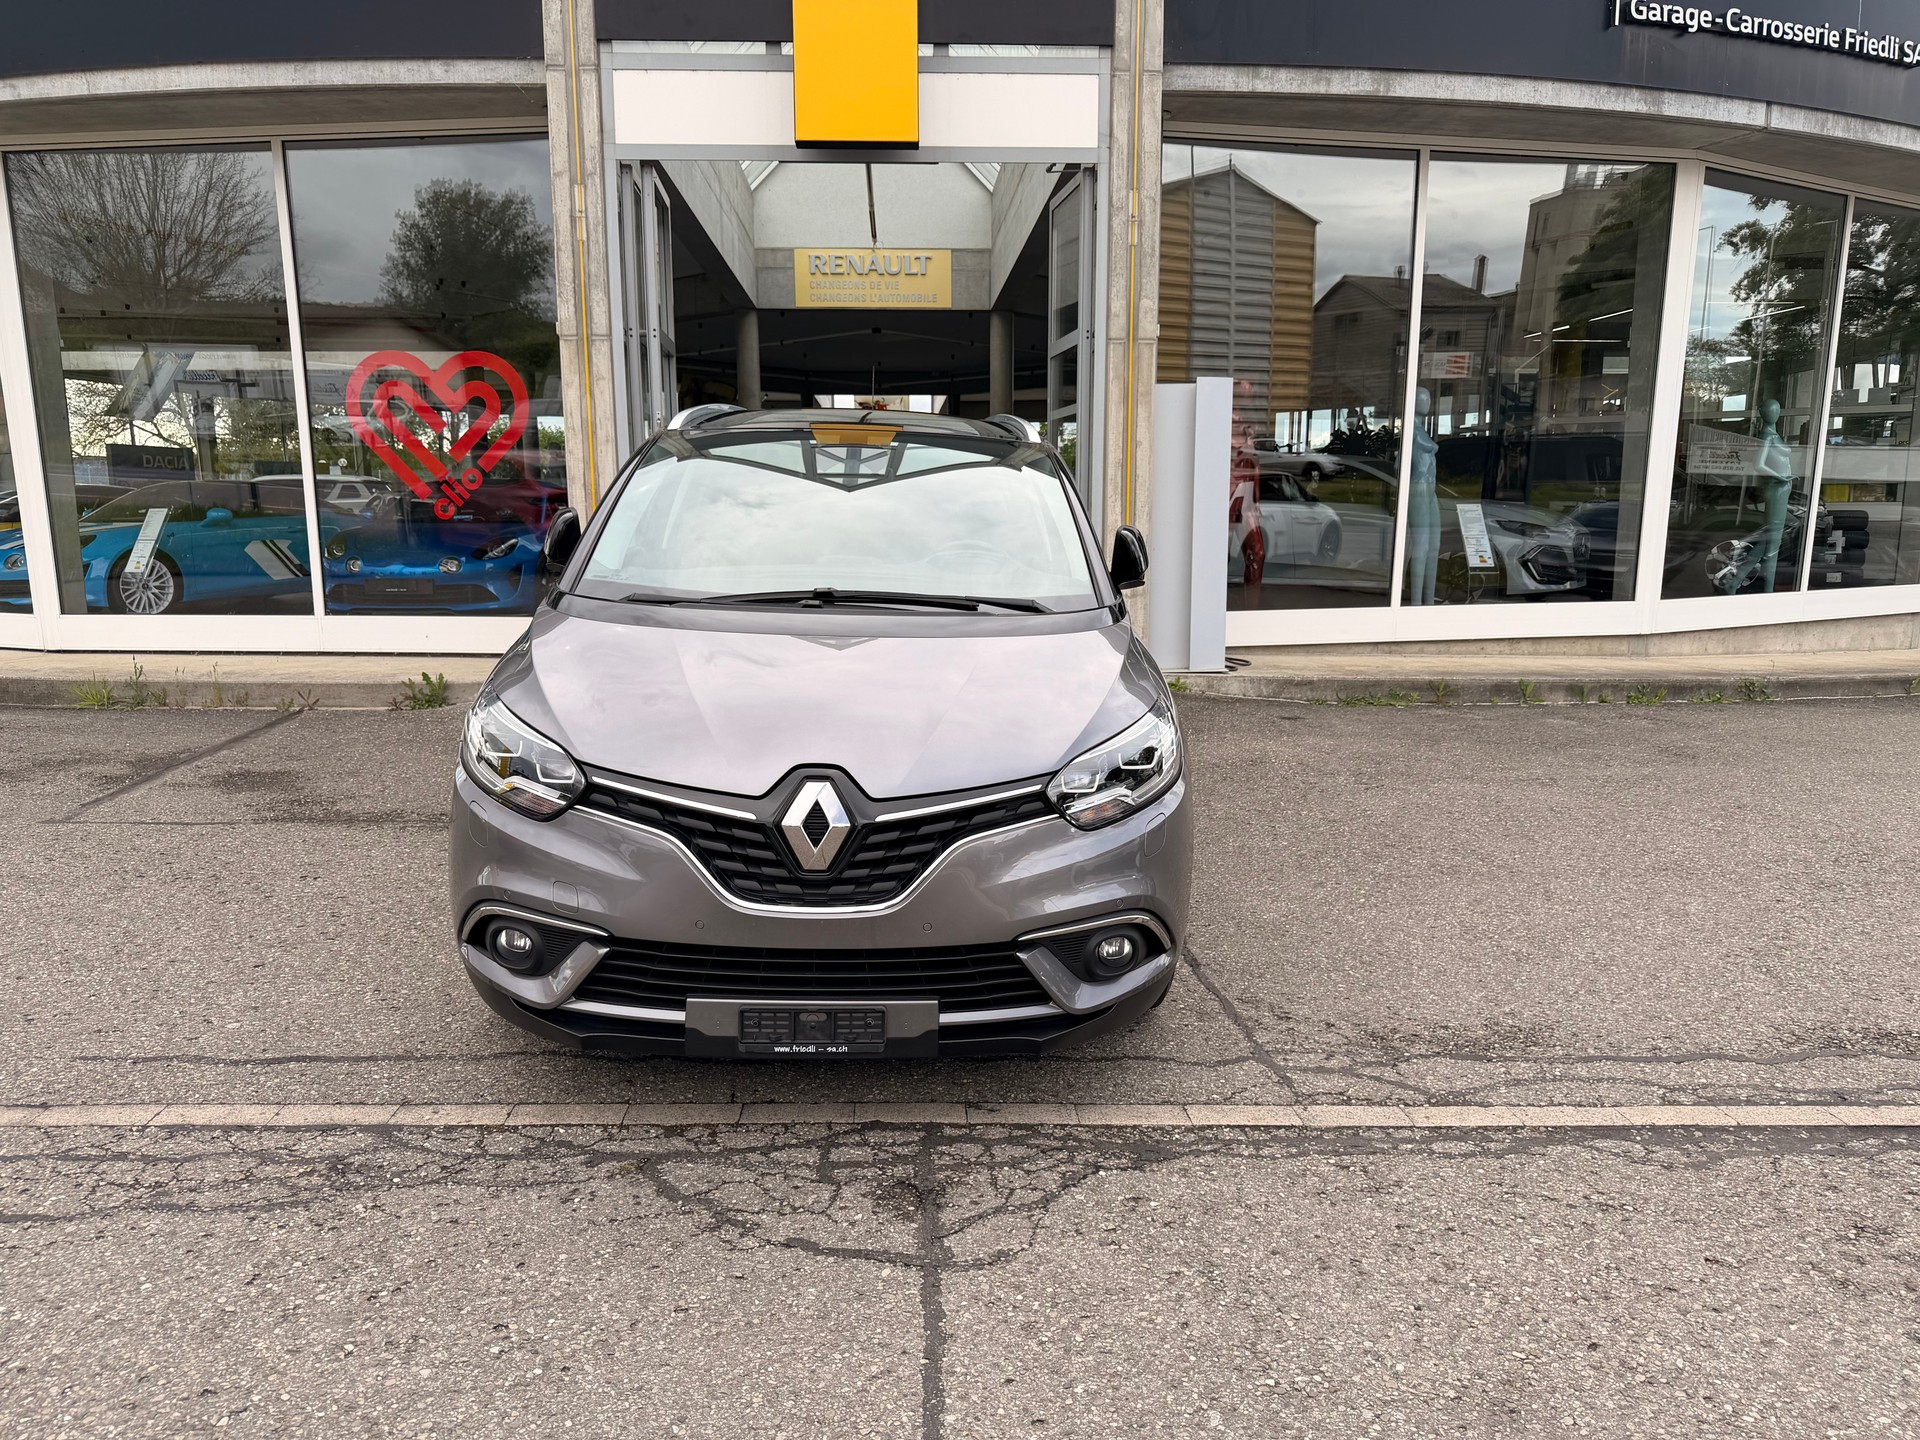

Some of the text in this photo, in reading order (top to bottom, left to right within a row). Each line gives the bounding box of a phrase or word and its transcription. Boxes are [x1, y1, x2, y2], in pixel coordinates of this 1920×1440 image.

[1845, 28, 1899, 60] Friedli
[808, 254, 933, 276] RENAULT
[809, 280, 900, 290] CHANGEONS DE VIE
[809, 293, 938, 303] CHANGEONS L'AUTOMOBILE
[142, 454, 189, 470] DACIA
[434, 467, 483, 520] clio
[826, 1044, 848, 1053] sa.ch
